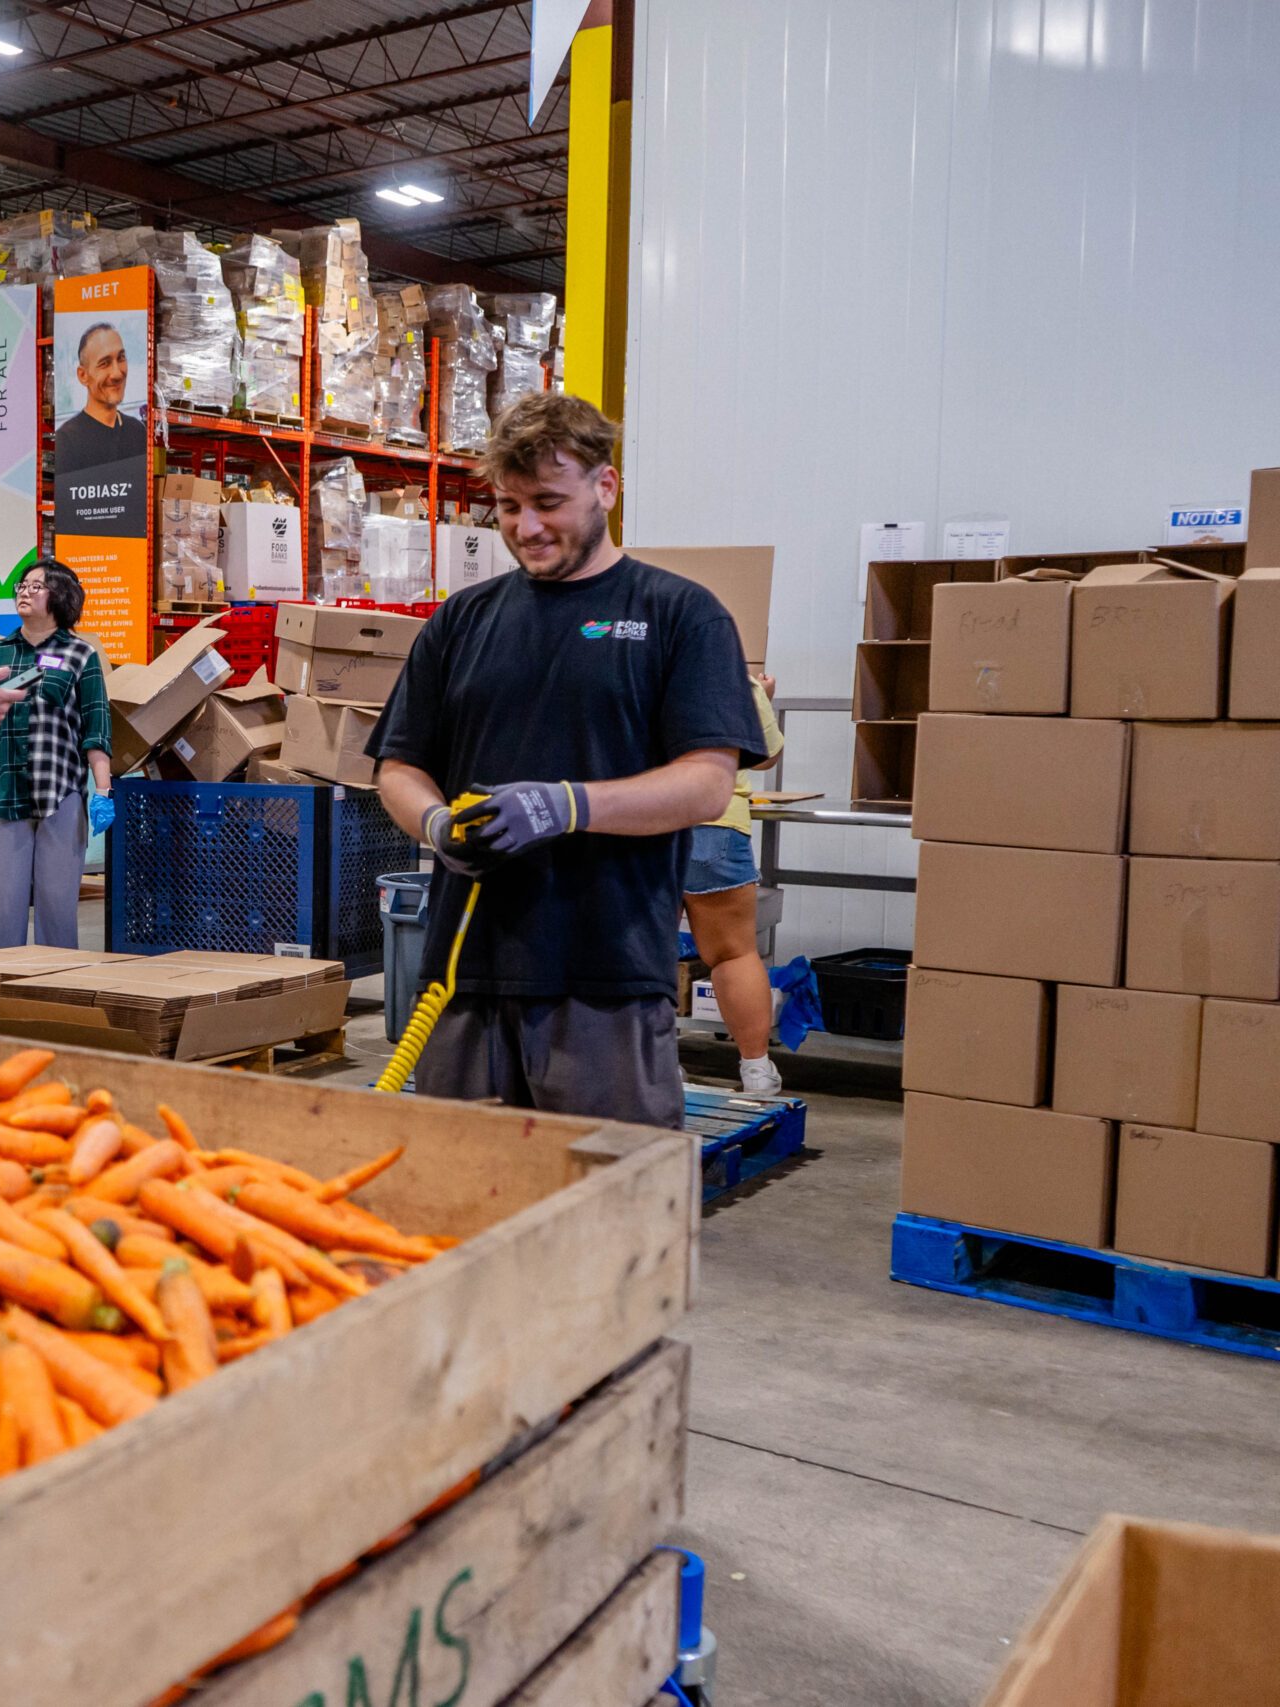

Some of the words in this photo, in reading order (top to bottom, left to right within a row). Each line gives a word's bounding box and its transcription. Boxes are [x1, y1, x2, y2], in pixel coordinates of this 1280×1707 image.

[81, 282, 120, 300] MEET
[76, 508, 92, 516] FOOD
[93, 507, 109, 515] BANK
[1177, 510, 1237, 526] NOTICE
[271, 542, 287, 552] FOOD
[271, 551, 287, 560] BANKS
[464, 561, 478, 570] FOOD
[617, 620, 648, 630] FOOD
[615, 627, 647, 637] BANKS
